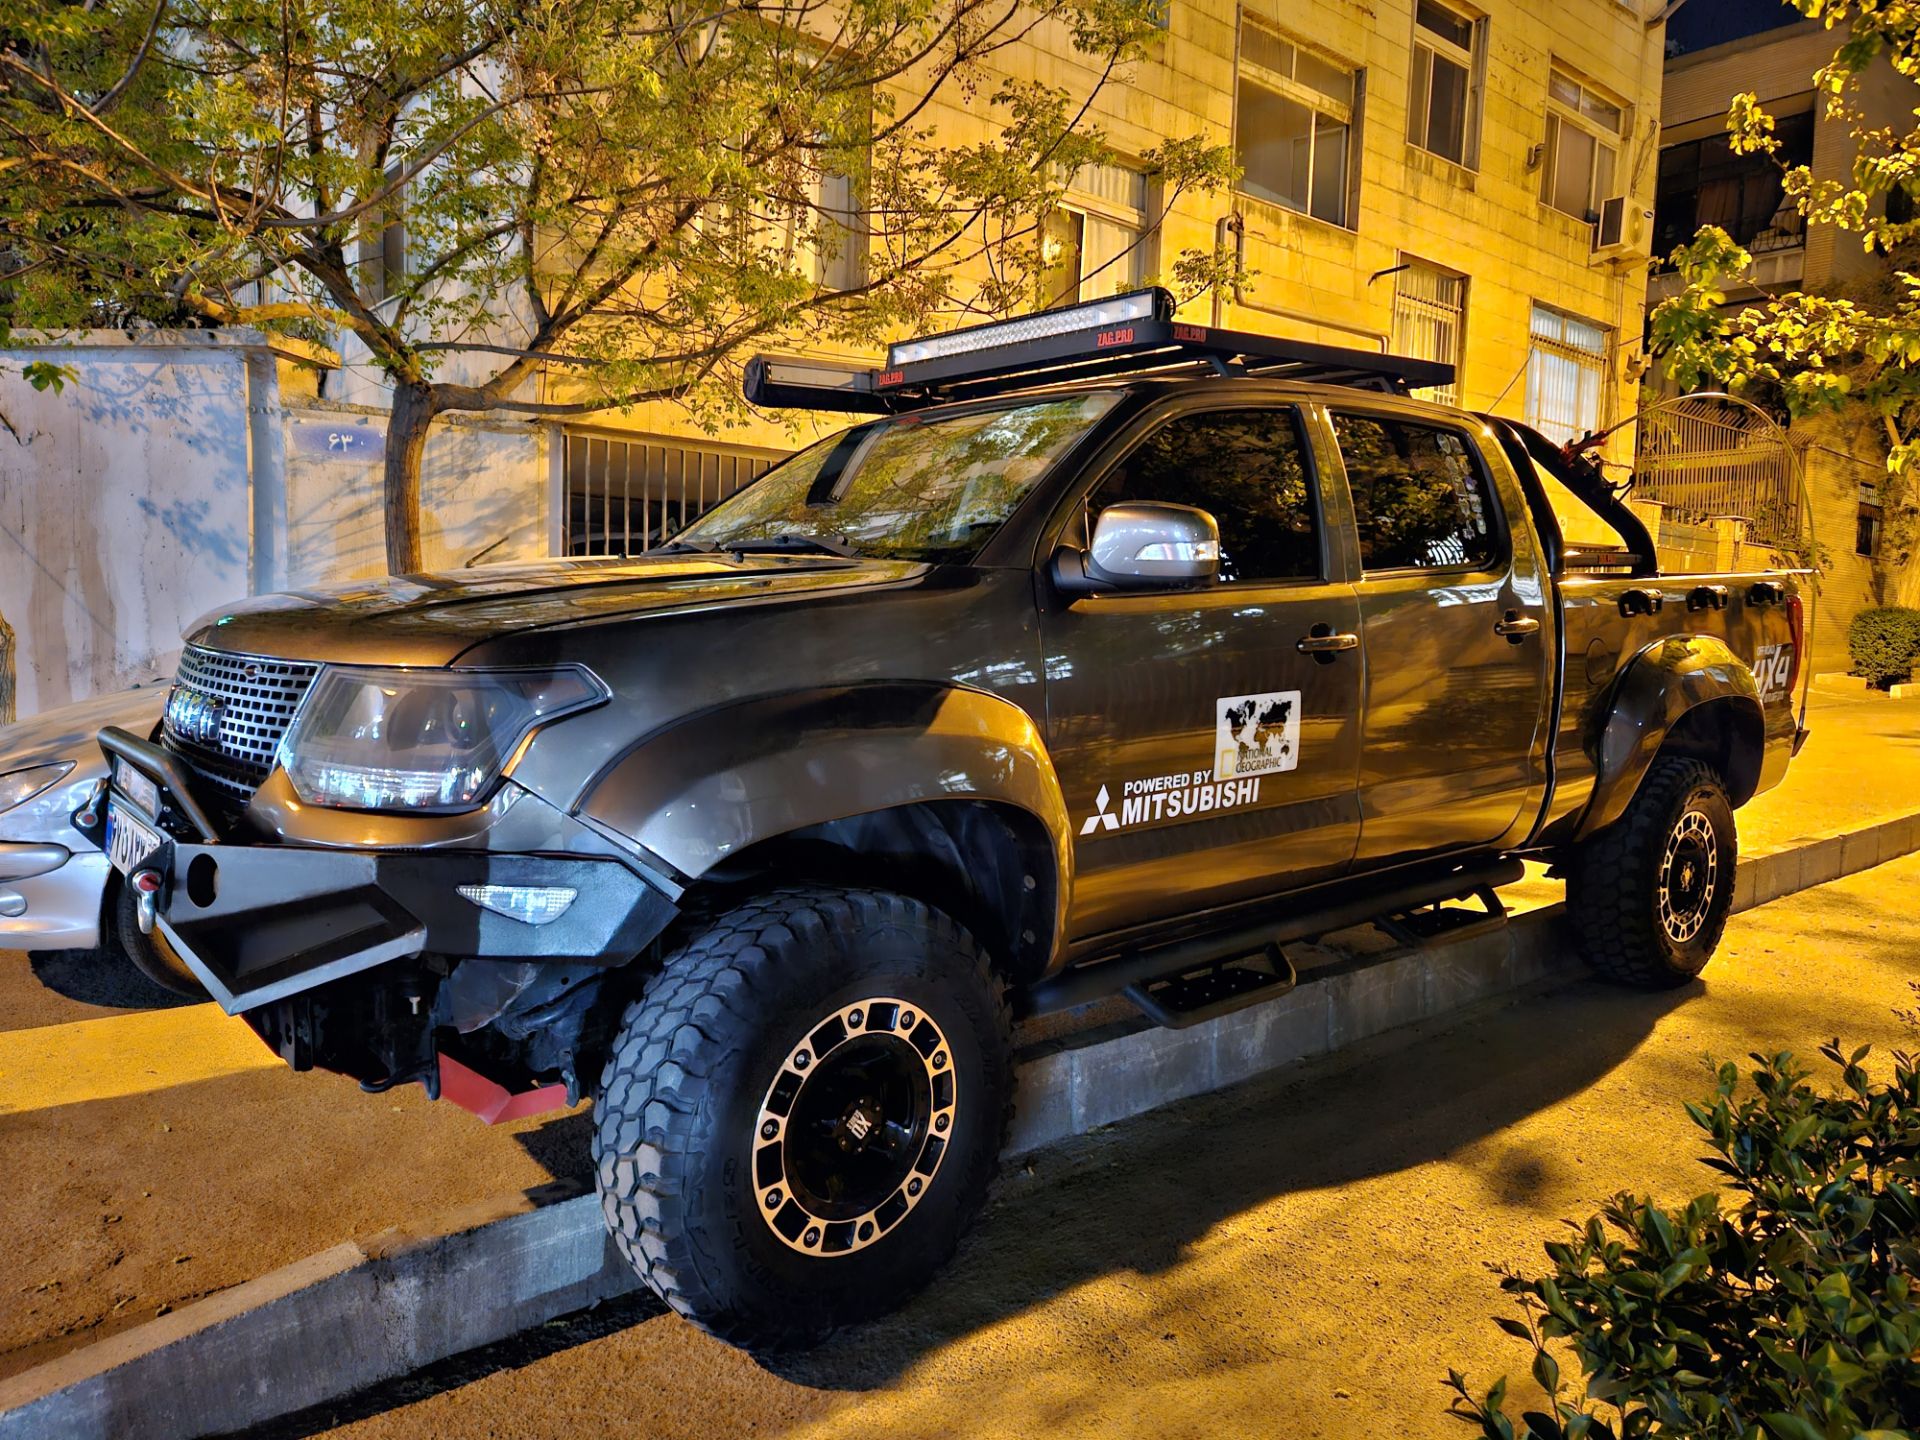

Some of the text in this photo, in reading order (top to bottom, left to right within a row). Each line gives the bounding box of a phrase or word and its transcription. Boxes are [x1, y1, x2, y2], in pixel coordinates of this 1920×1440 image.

[1097, 328, 1134, 347] ZAG.PRO
[1173, 325, 1207, 343] ZAG.PRO
[1236, 747, 1273, 763] NATIONAL
[1235, 756, 1282, 774] GEOGRAPHIC
[1123, 769, 1212, 796] POWERED BY
[1121, 777, 1261, 826] MITSUBISHI
